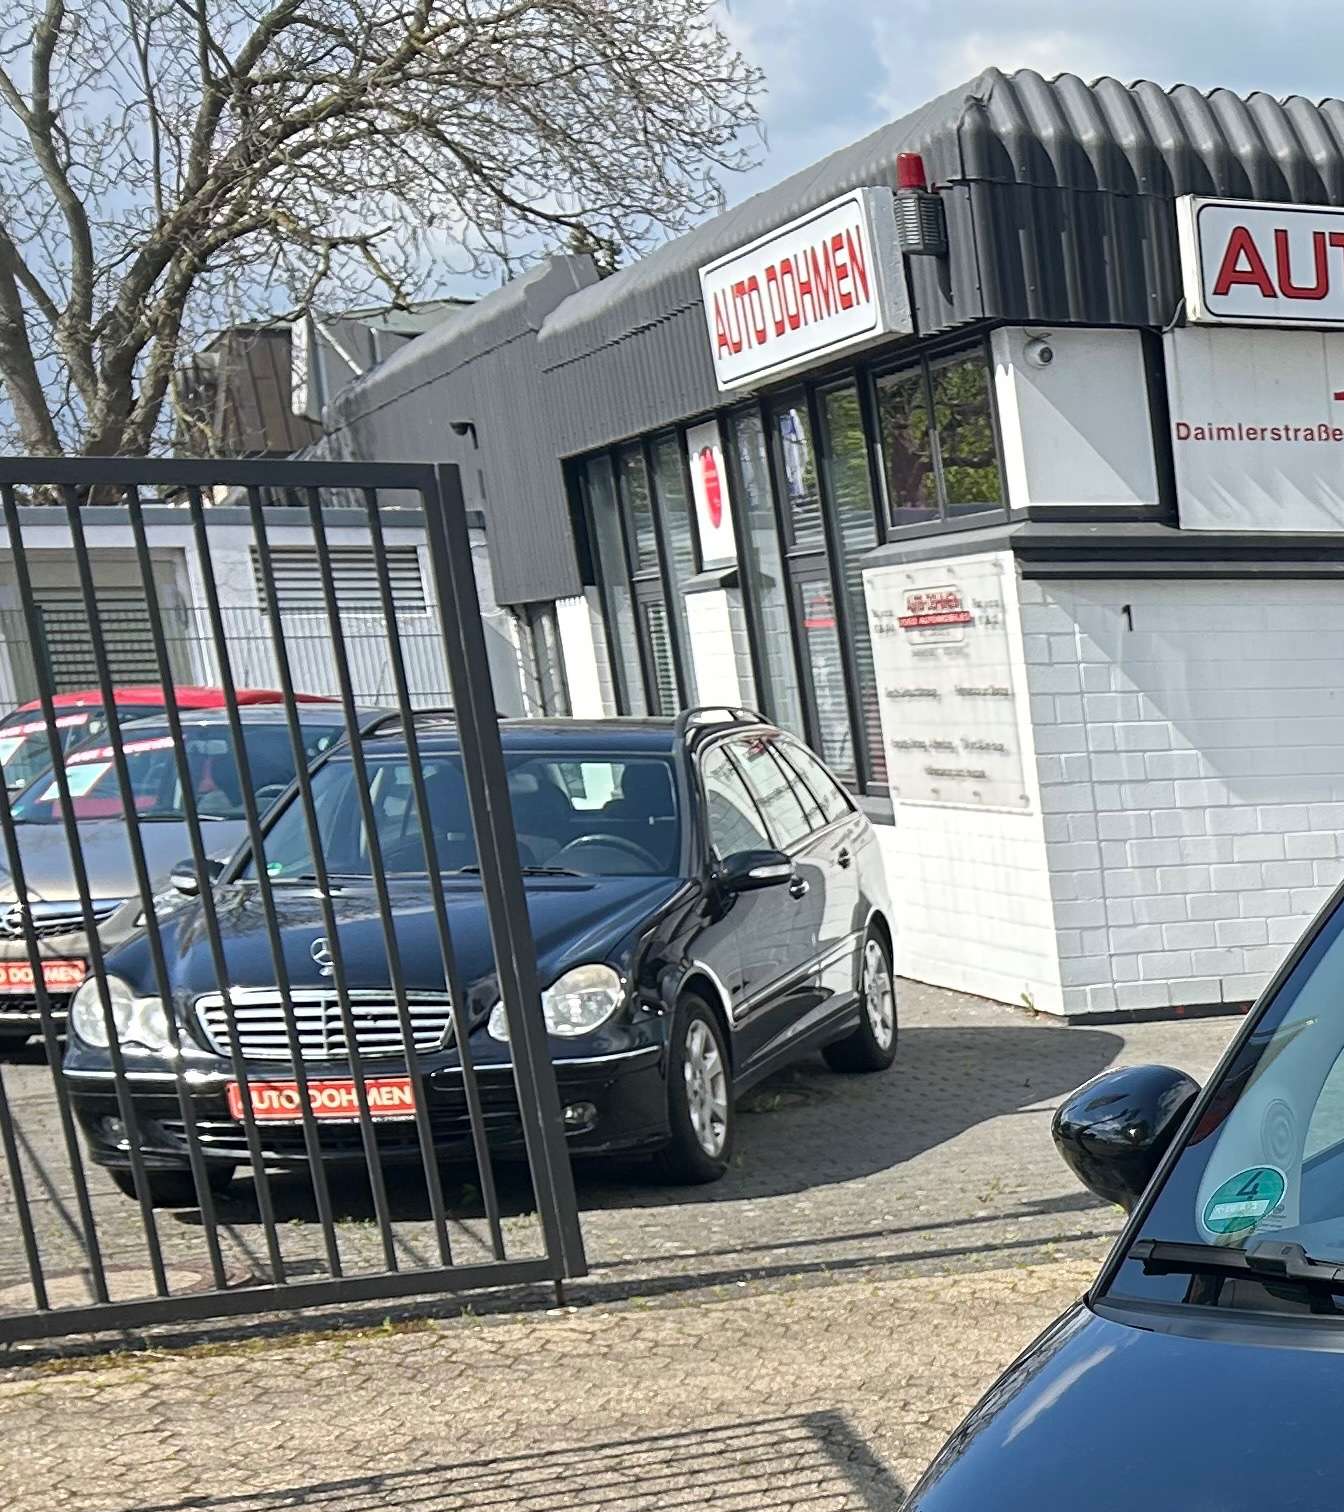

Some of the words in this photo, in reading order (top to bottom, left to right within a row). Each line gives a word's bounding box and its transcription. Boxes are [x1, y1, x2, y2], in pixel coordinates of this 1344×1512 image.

[714, 275, 766, 360] AUTO
[765, 225, 870, 337] DOHMEN
[1175, 420, 1344, 443] Daimlerstraße
[238, 1089, 300, 1110] UTO
[1236, 1171, 1262, 1199] 4
